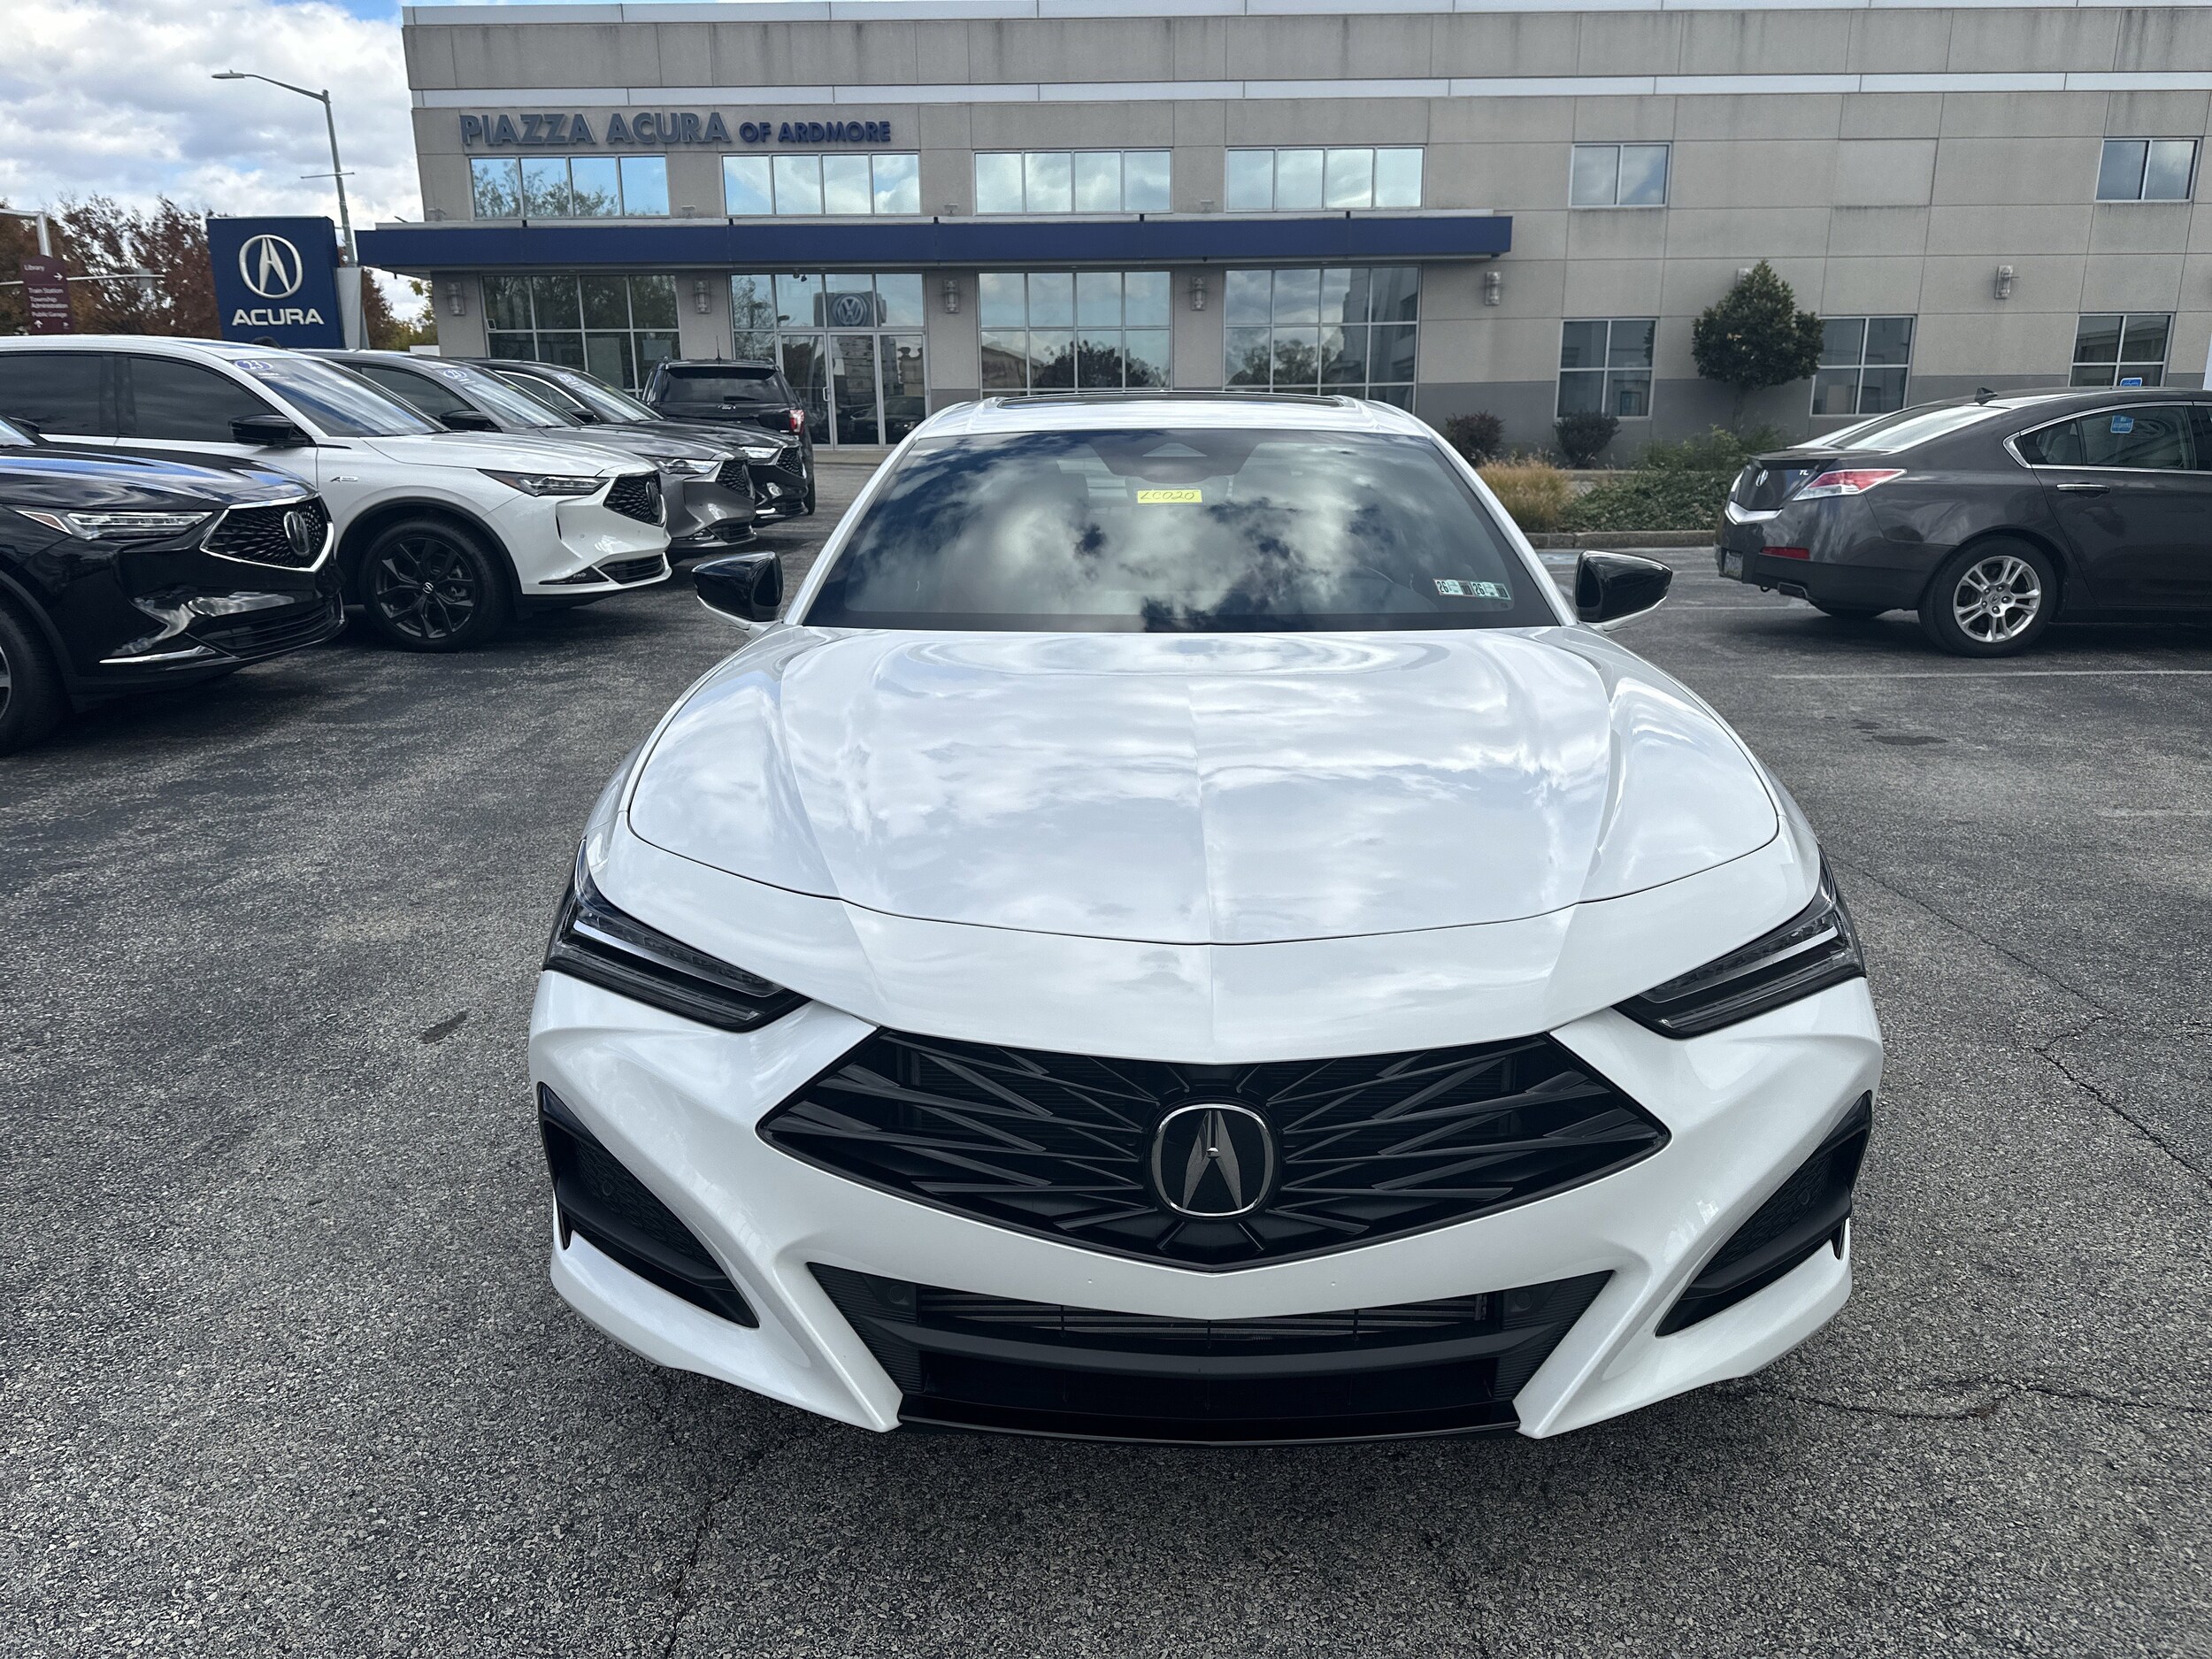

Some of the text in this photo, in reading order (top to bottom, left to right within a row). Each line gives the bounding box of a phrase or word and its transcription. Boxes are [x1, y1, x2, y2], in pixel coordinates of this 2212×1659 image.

[459, 111, 891, 144] PIAZZA ACURA OF ARDMORE
[232, 308, 325, 326] ACURA
[242, 359, 264, 370] 23
[1437, 580, 1449, 593] 26
[1472, 583, 1486, 595] 26
